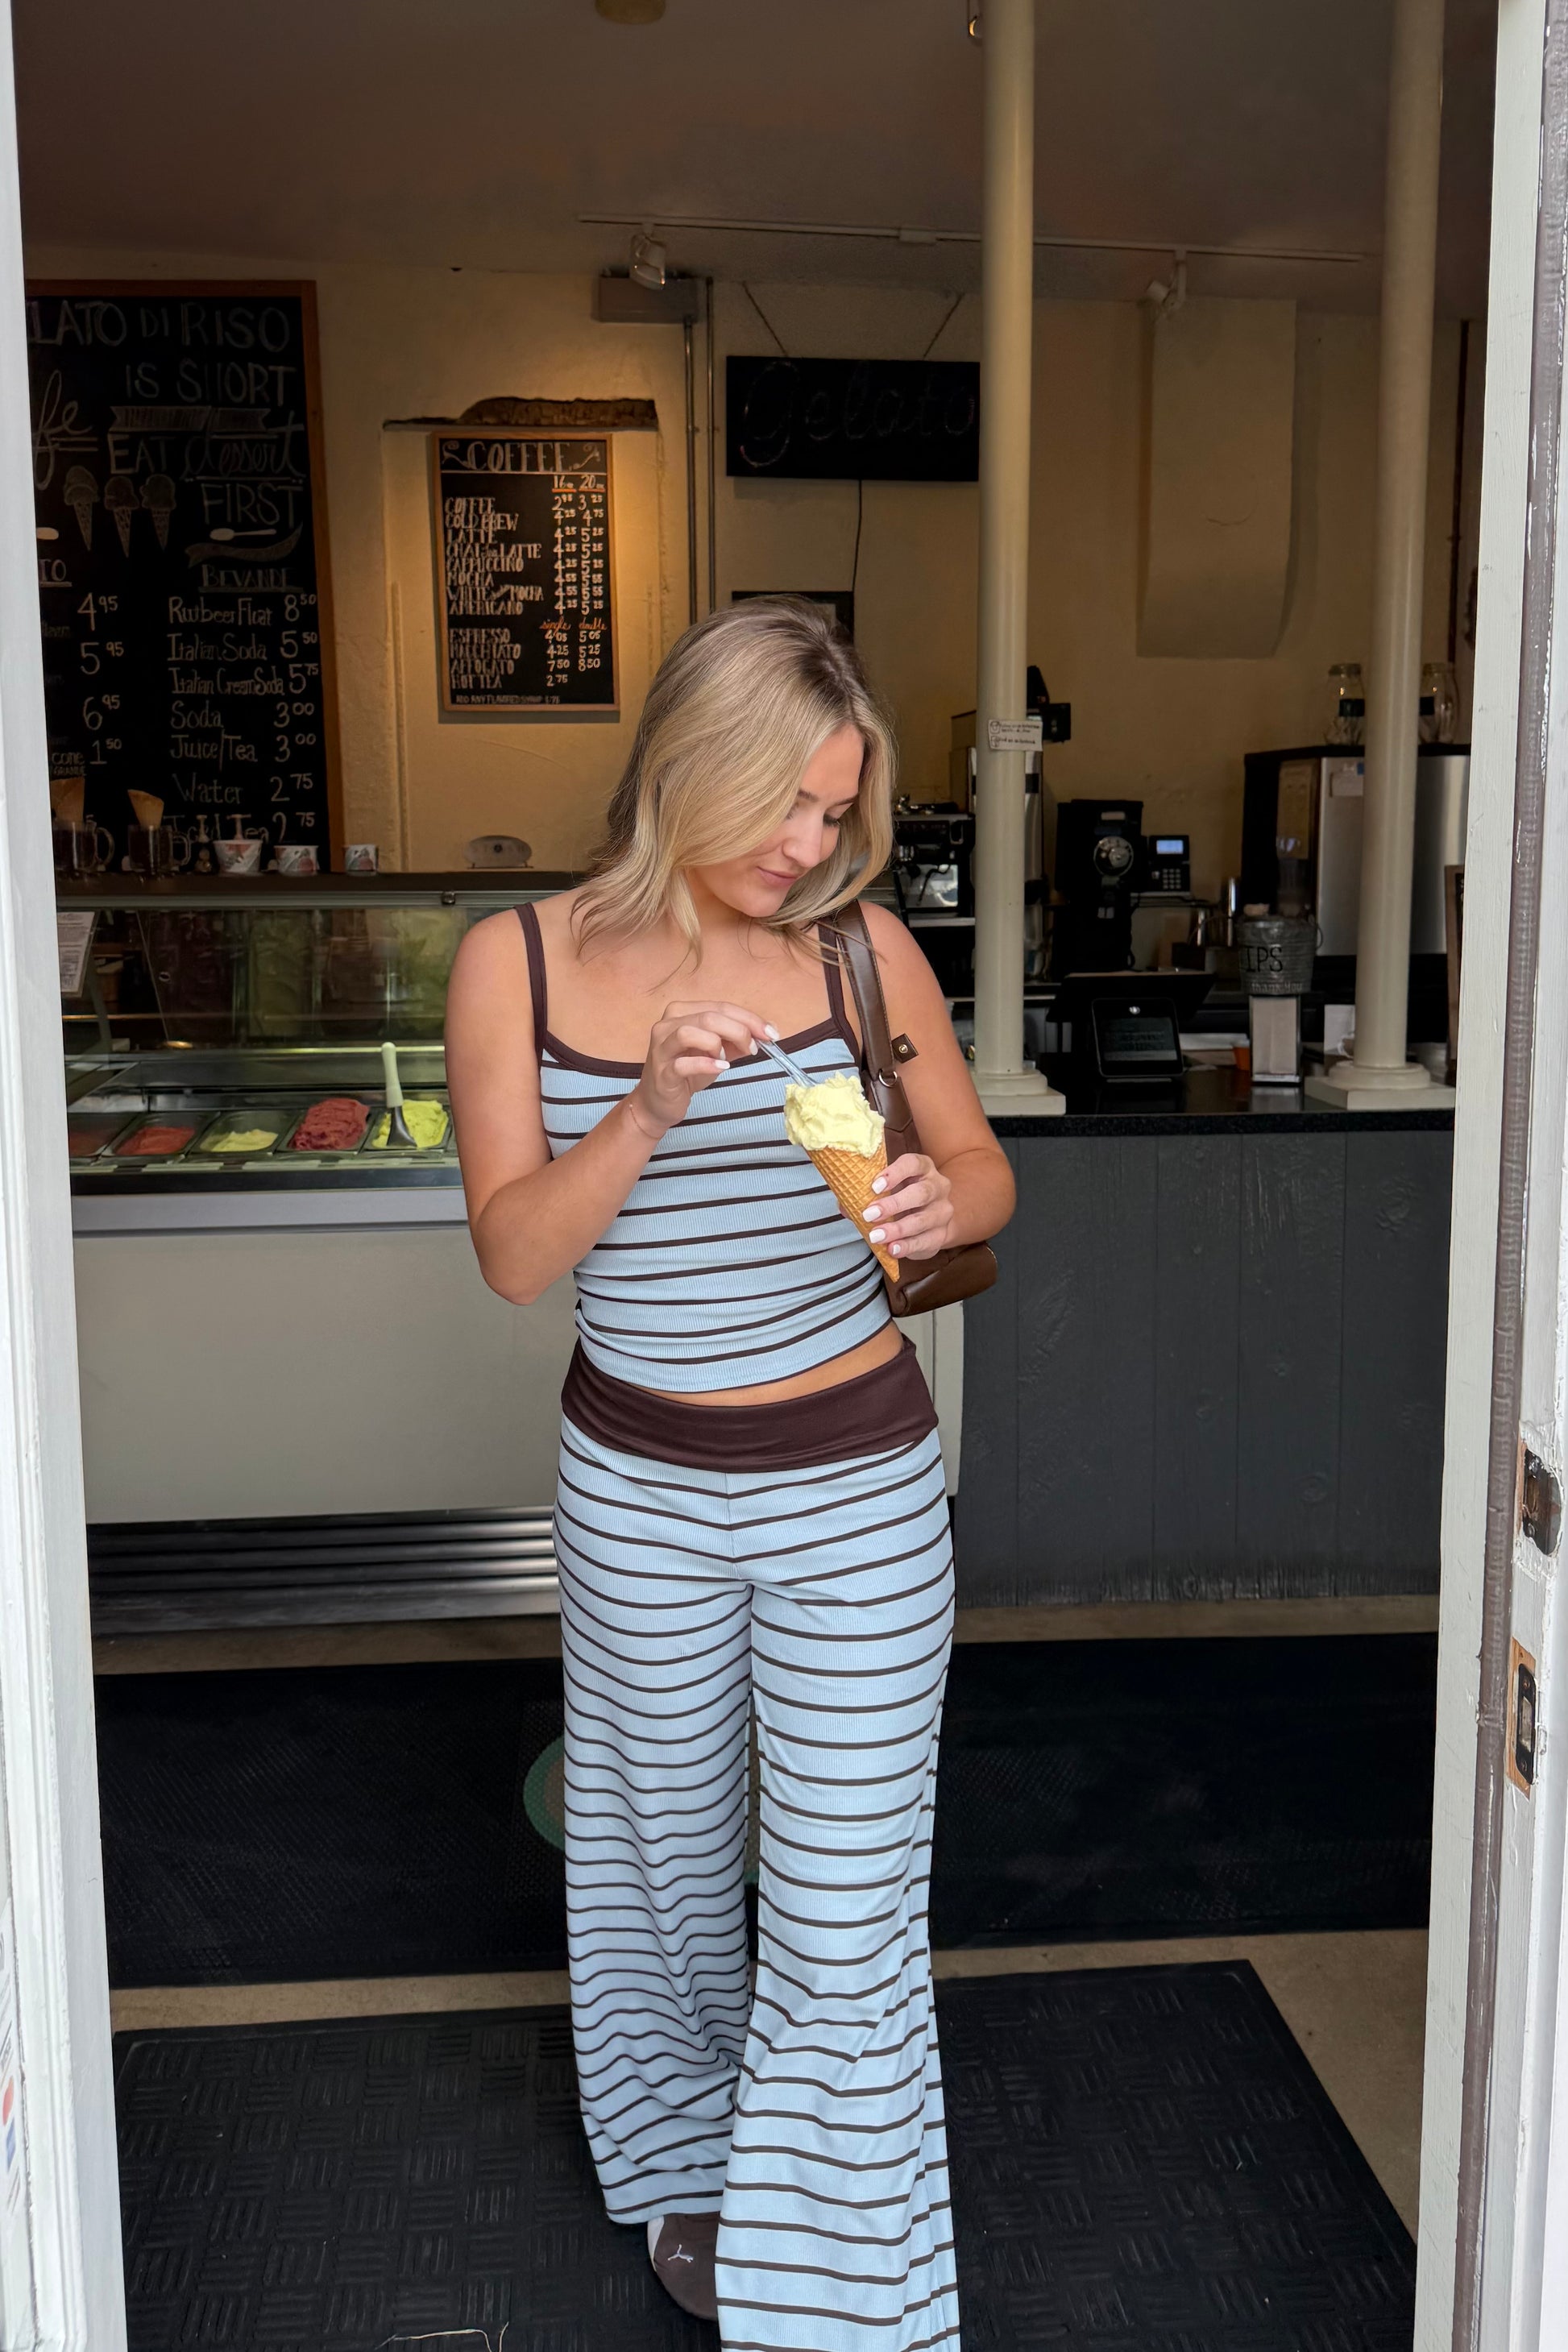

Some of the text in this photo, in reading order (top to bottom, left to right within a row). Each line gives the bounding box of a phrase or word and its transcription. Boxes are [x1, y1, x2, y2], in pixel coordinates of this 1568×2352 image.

[140, 306, 170, 338] DI
[181, 301, 292, 355] RISO
[125, 358, 297, 408] IS SHORT
[107, 431, 177, 475] EAT
[466, 440, 570, 472] COFFEE
[200, 482, 304, 529] FIRST
[221, 632, 268, 662] Soda
[169, 699, 225, 730] Soda
[171, 771, 245, 806] Water
